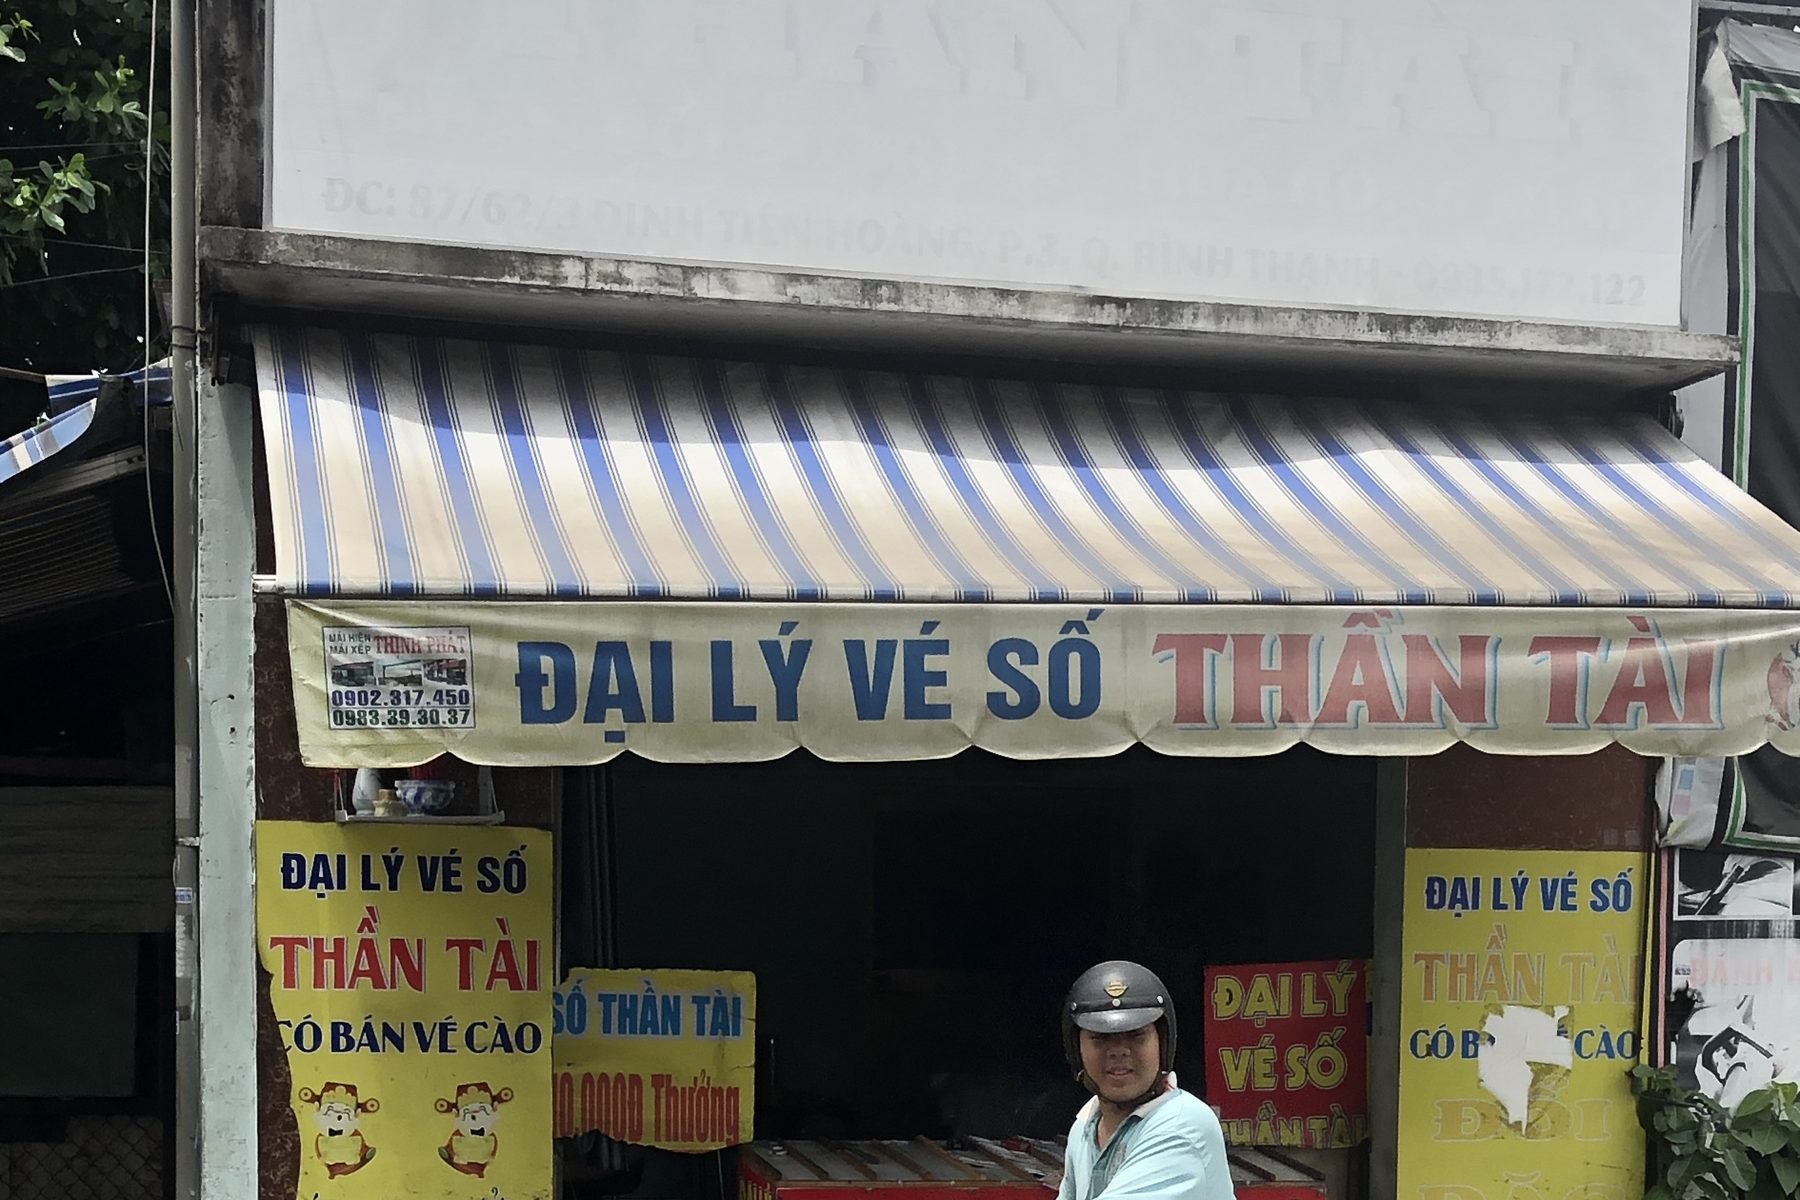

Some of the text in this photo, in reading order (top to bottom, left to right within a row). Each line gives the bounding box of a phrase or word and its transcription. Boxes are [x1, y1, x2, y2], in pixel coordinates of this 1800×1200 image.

[331, 689, 470, 707] 0902.317.450
[514, 608, 1727, 743] ĐẠI LÝ VÉ SỐ THẦN TÀI
[332, 708, 471, 726] 0983.39.30.37
[281, 844, 528, 899] ĐẠI LÝ VÉ SỐ
[1425, 867, 1634, 918] ĐẠI LÝ VÉ SỐ
[269, 905, 426, 993] THẦN
[445, 916, 541, 992] TÀI
[1413, 923, 1545, 1005] THẦN
[553, 979, 742, 1036] SỐ THẦN TÀI
[1212, 960, 1356, 1027] ĐẠI LÝ
[330, 1014, 404, 1053] BÁN
[412, 1015, 457, 1053] VÉ
[464, 1015, 542, 1054] CÀO
[1219, 1027, 1347, 1092] VÉ SỐ
[1574, 1024, 1638, 1059] CÀO
